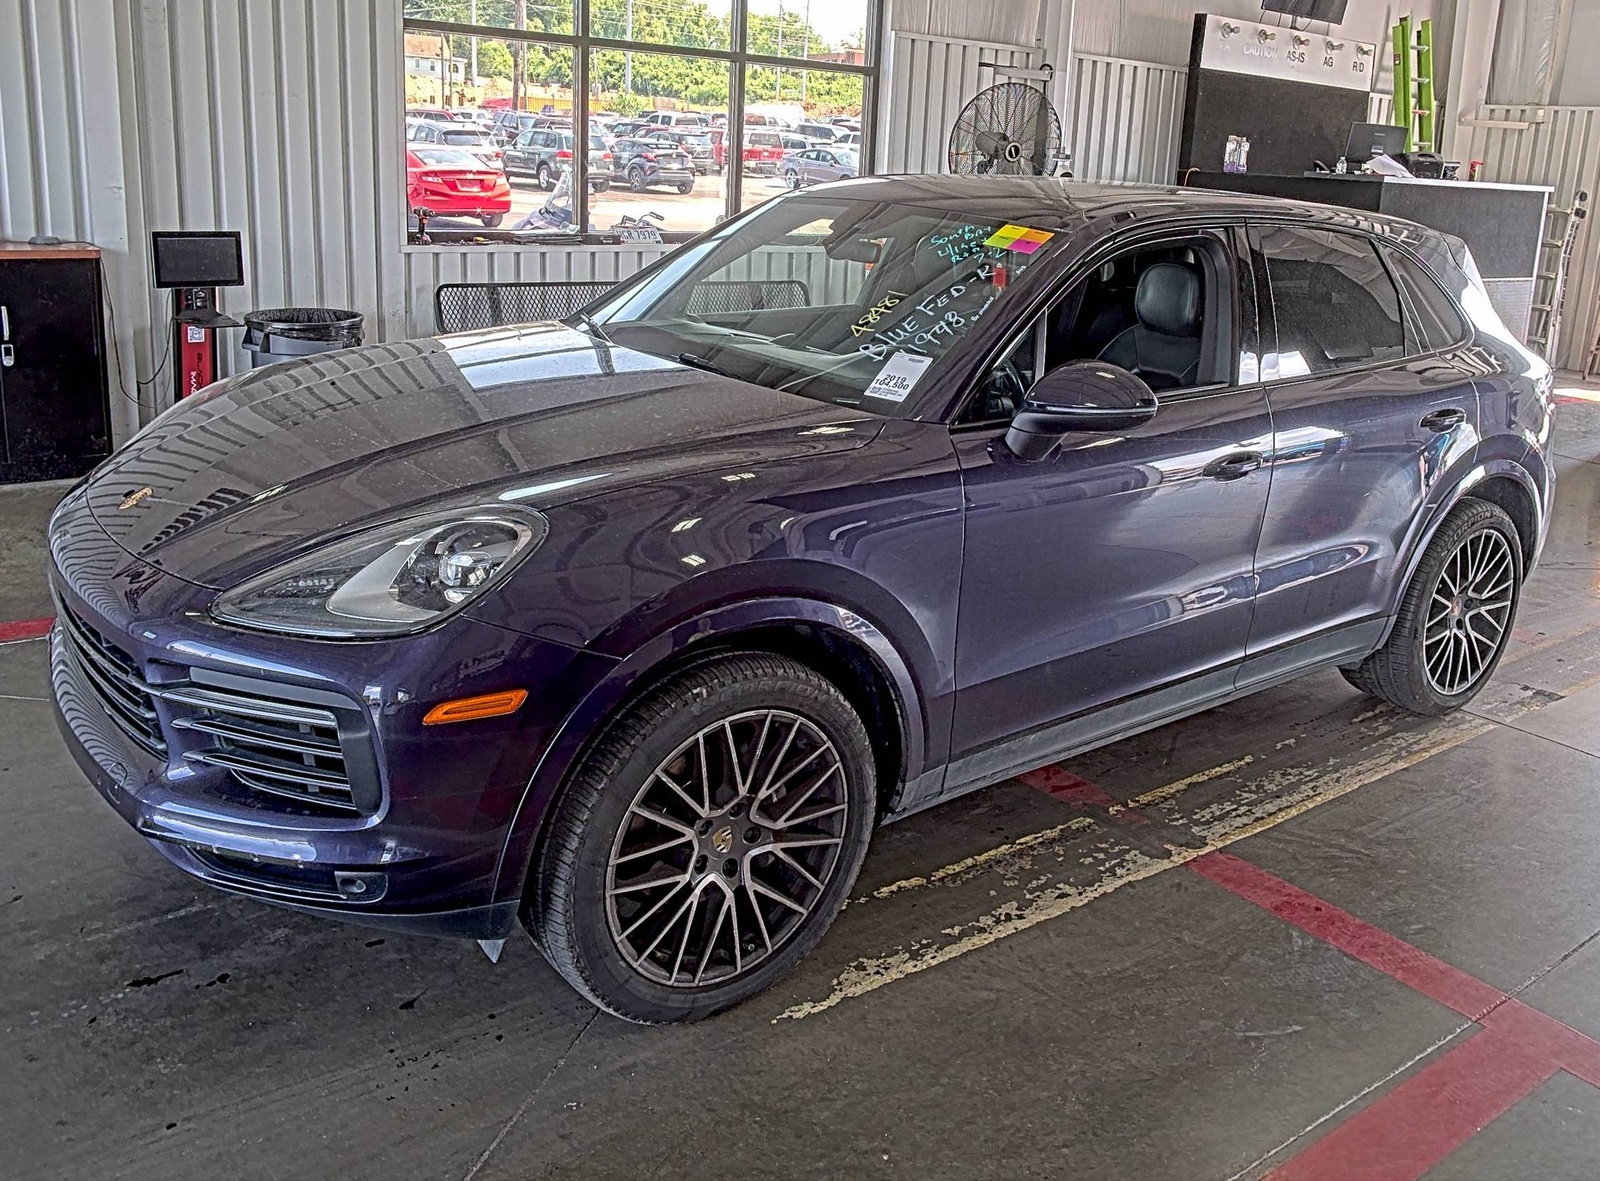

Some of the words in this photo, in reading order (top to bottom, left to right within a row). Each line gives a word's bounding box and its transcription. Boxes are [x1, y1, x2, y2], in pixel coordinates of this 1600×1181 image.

[1243, 44, 1278, 58] CAUTION
[1285, 50, 1305, 63] AS-IS
[1322, 56, 1333, 67] AG
[634, 229, 658, 240] 7979
[884, 373, 907, 383] 2019
